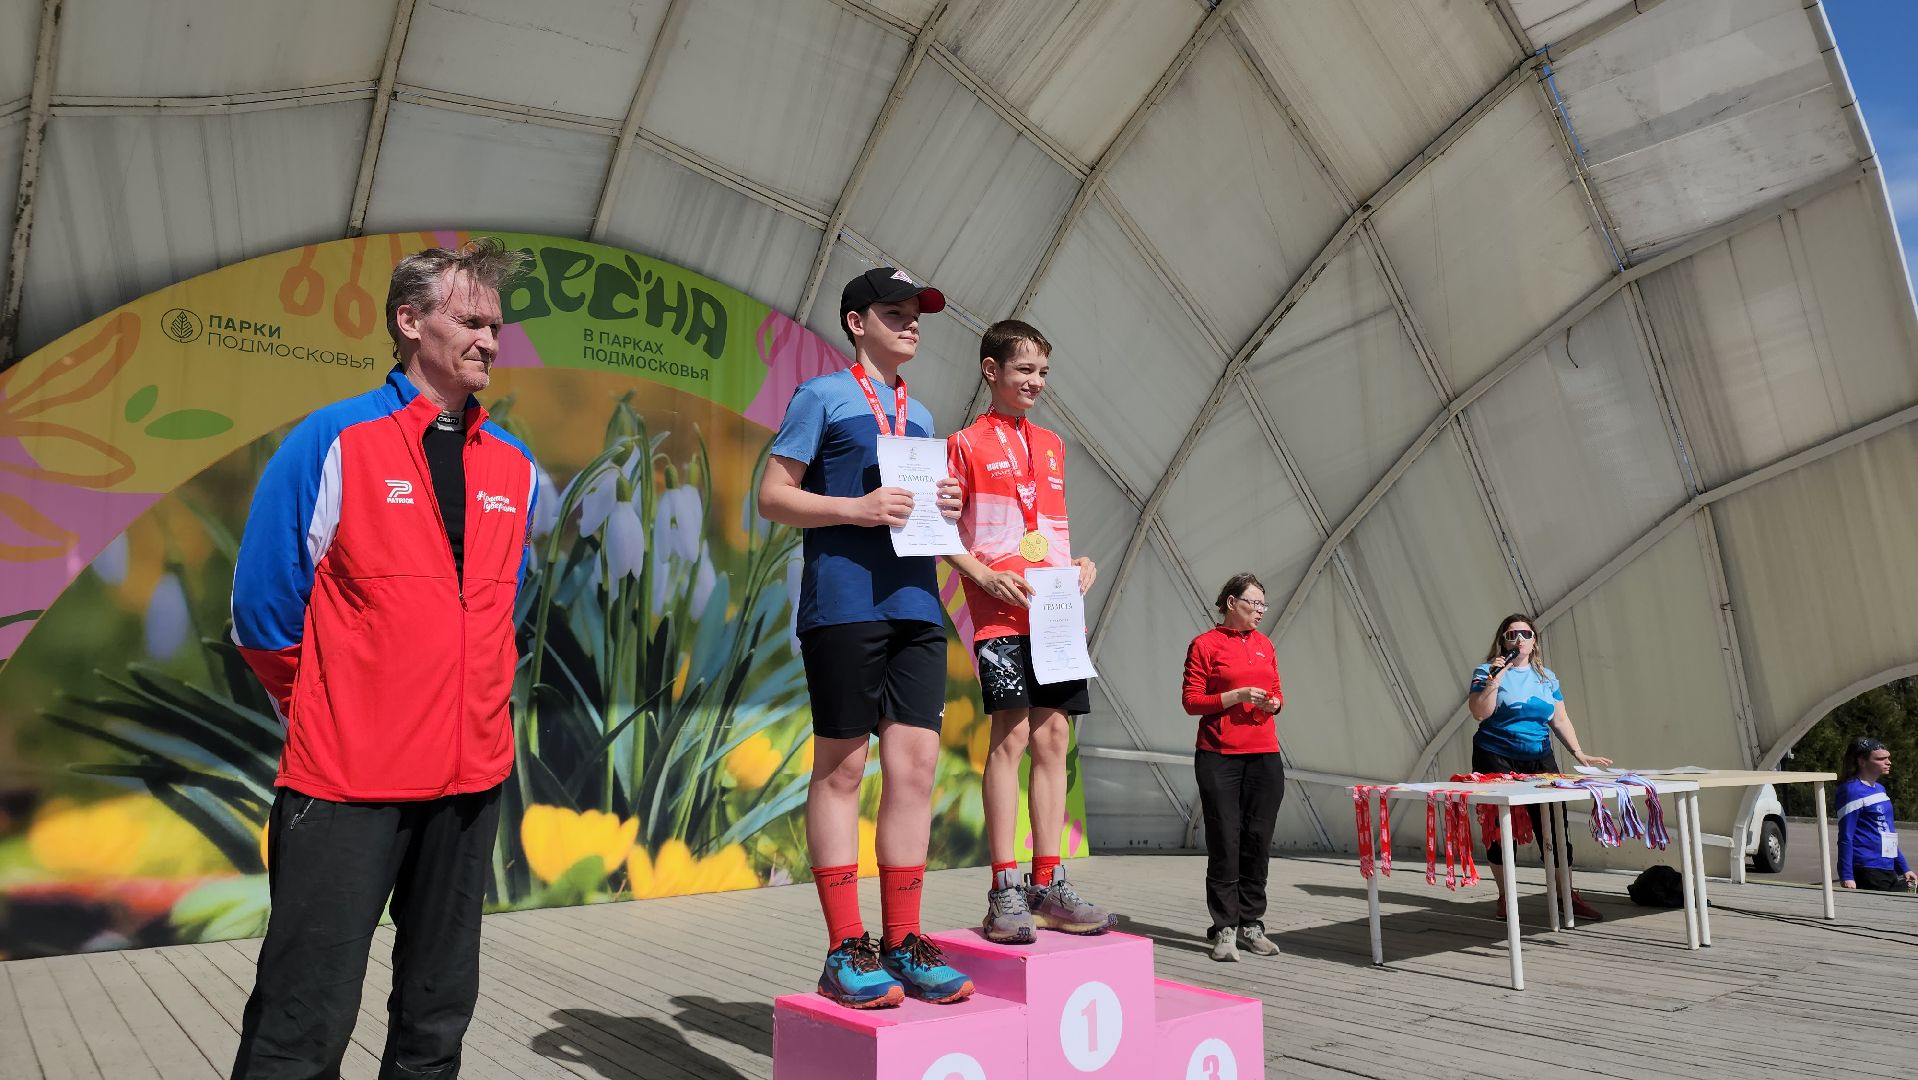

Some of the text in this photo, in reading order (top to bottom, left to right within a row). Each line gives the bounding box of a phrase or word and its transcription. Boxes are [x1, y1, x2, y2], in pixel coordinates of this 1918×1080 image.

[209, 314, 281, 339] ПАРКИ
[583, 328, 664, 355] В ПАРКАХ
[208, 332, 375, 371] ПОДМОСКОВЬЯ
[583, 346, 709, 381] ПОДМОСКОВЬЯ
[1081, 998, 1099, 1053] 1
